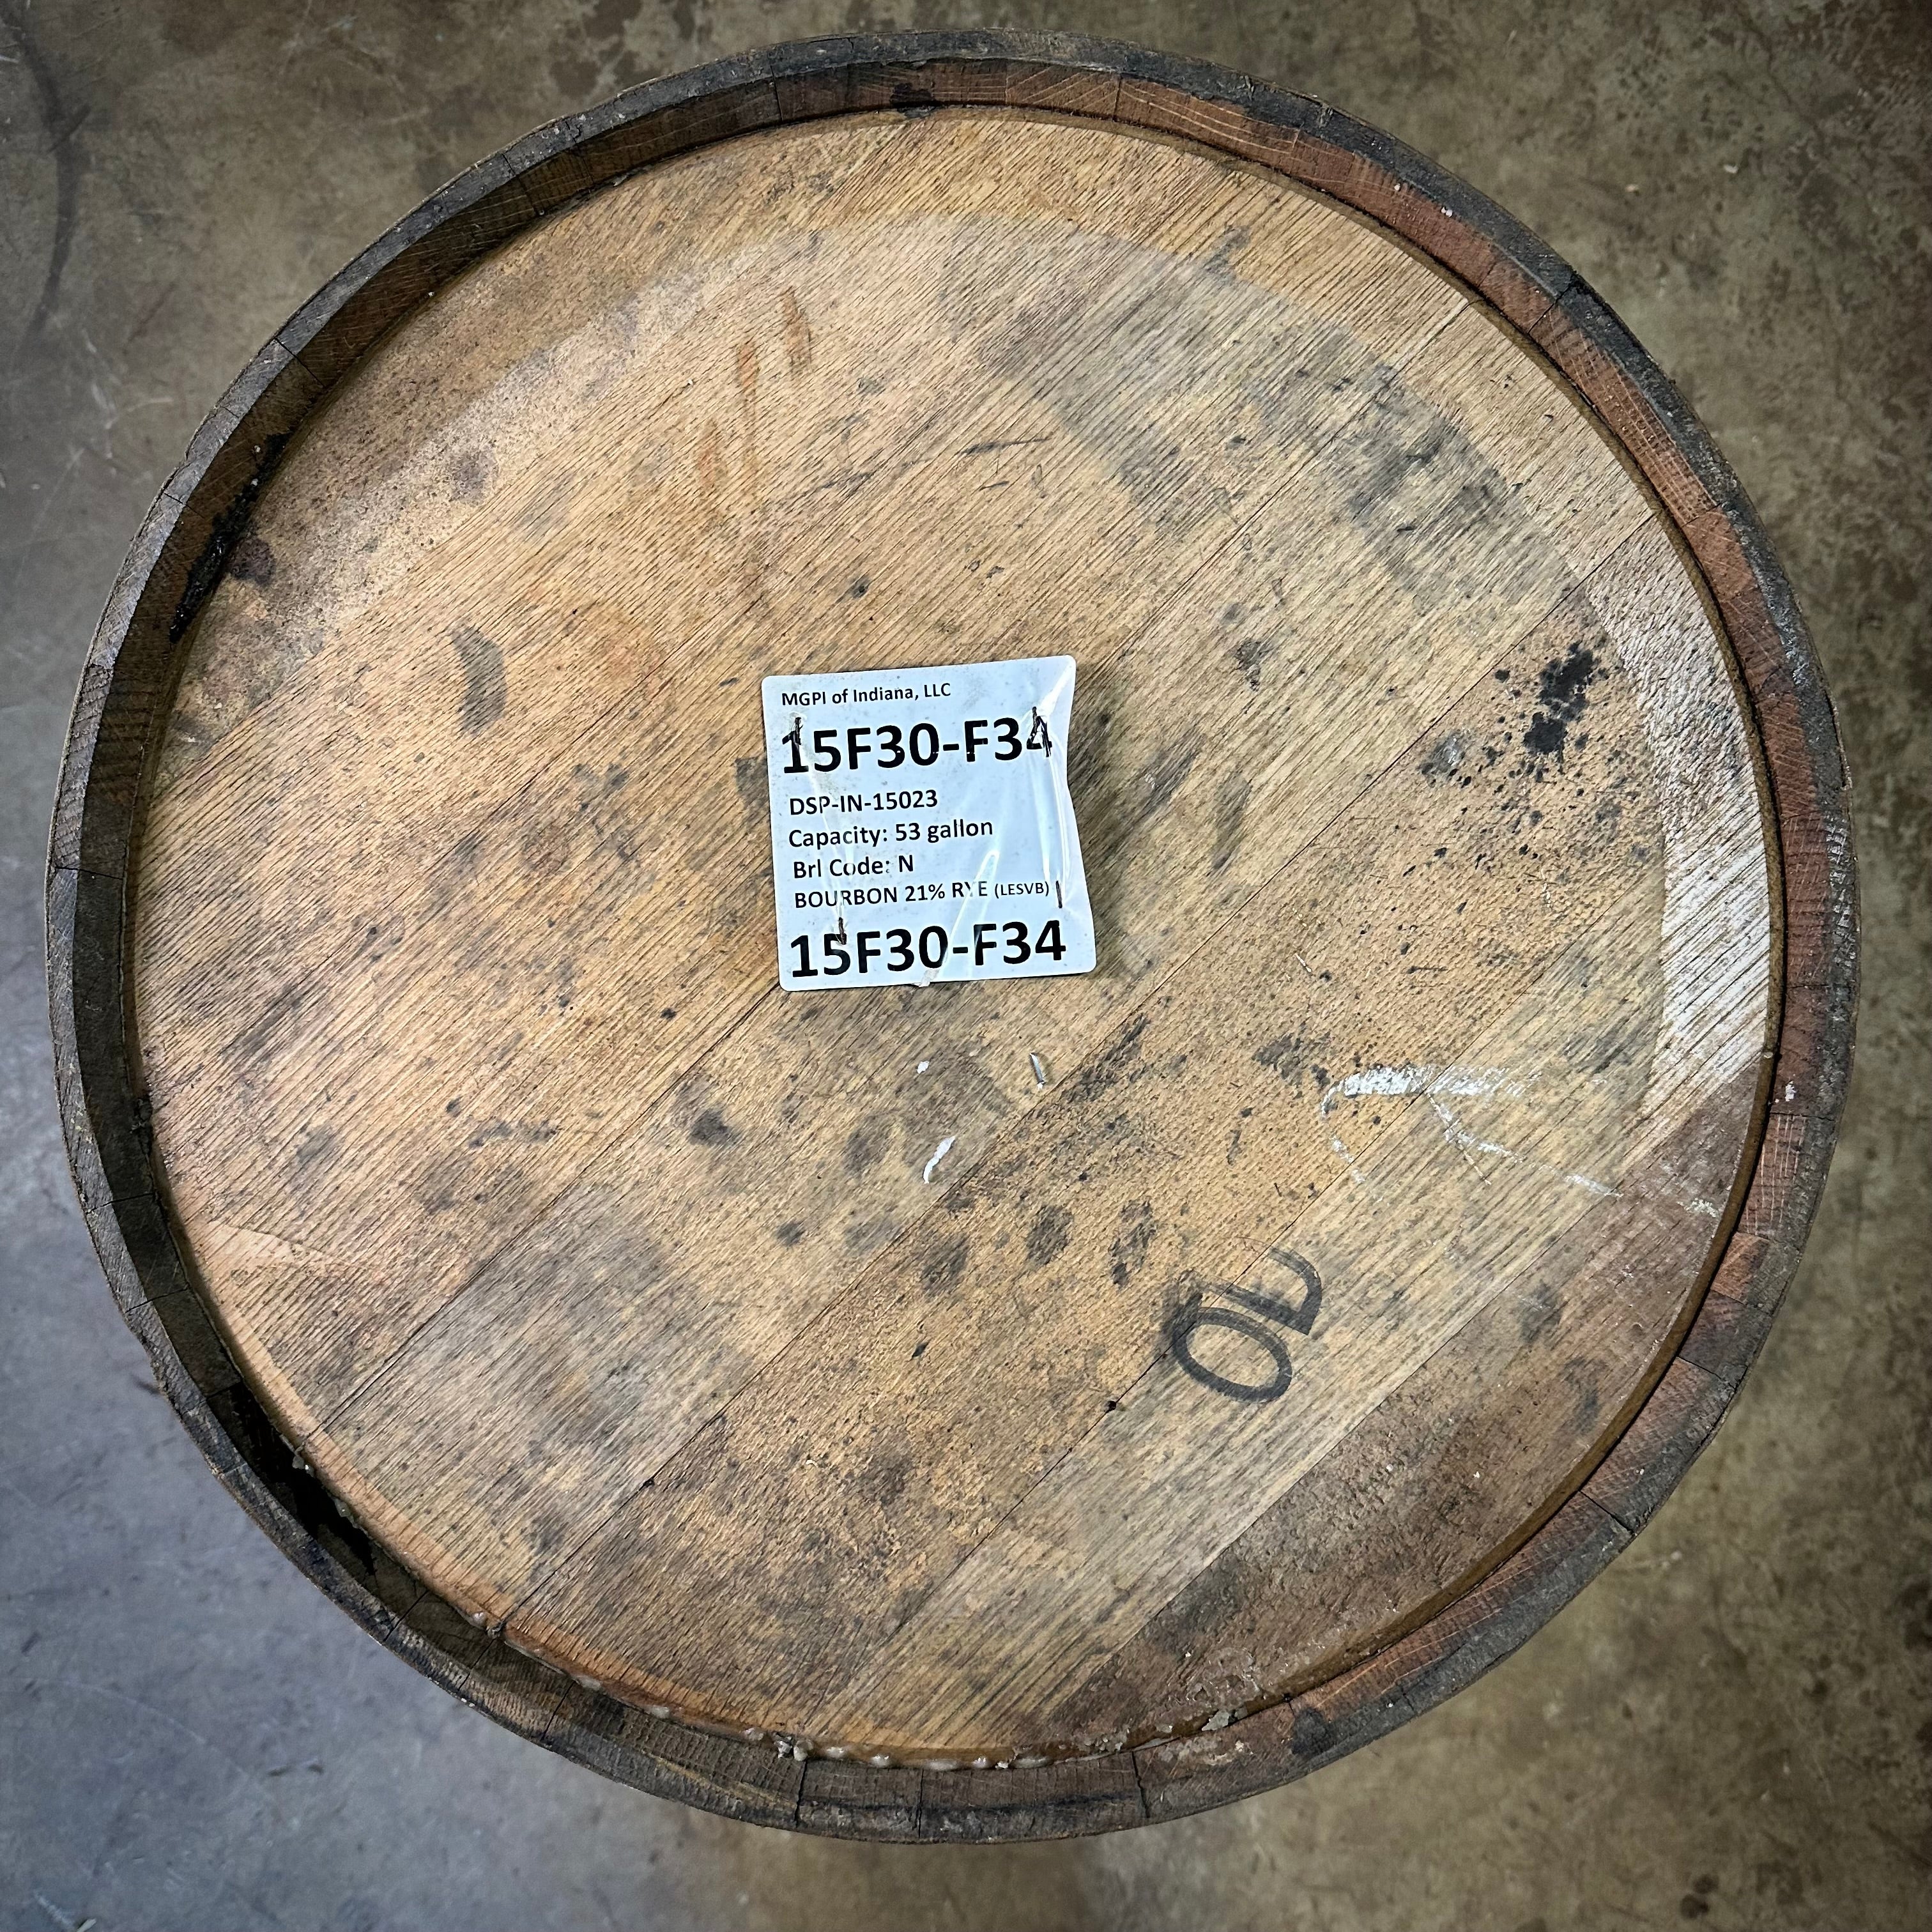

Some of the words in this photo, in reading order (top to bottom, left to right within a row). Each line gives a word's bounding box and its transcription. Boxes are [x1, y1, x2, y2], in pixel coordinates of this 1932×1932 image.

[782, 692, 825, 705] MGPI
[832, 689, 848, 703] of
[854, 687, 918, 702] Indiana,
[924, 683, 950, 697] LLC
[782, 716, 1052, 774] 15F30-F34
[790, 790, 937, 815] DSP-IN-15023
[789, 826, 887, 850] Capacity:
[896, 823, 920, 841] 53
[928, 819, 992, 843] gallon
[794, 859, 821, 878] Brl
[830, 857, 889, 876] Code:
[899, 855, 913, 872] N
[795, 887, 897, 908] BOURBON
[905, 884, 945, 901] 21%
[995, 882, 1048, 898] (LESVB)
[791, 919, 1066, 978] 15F30-F34
